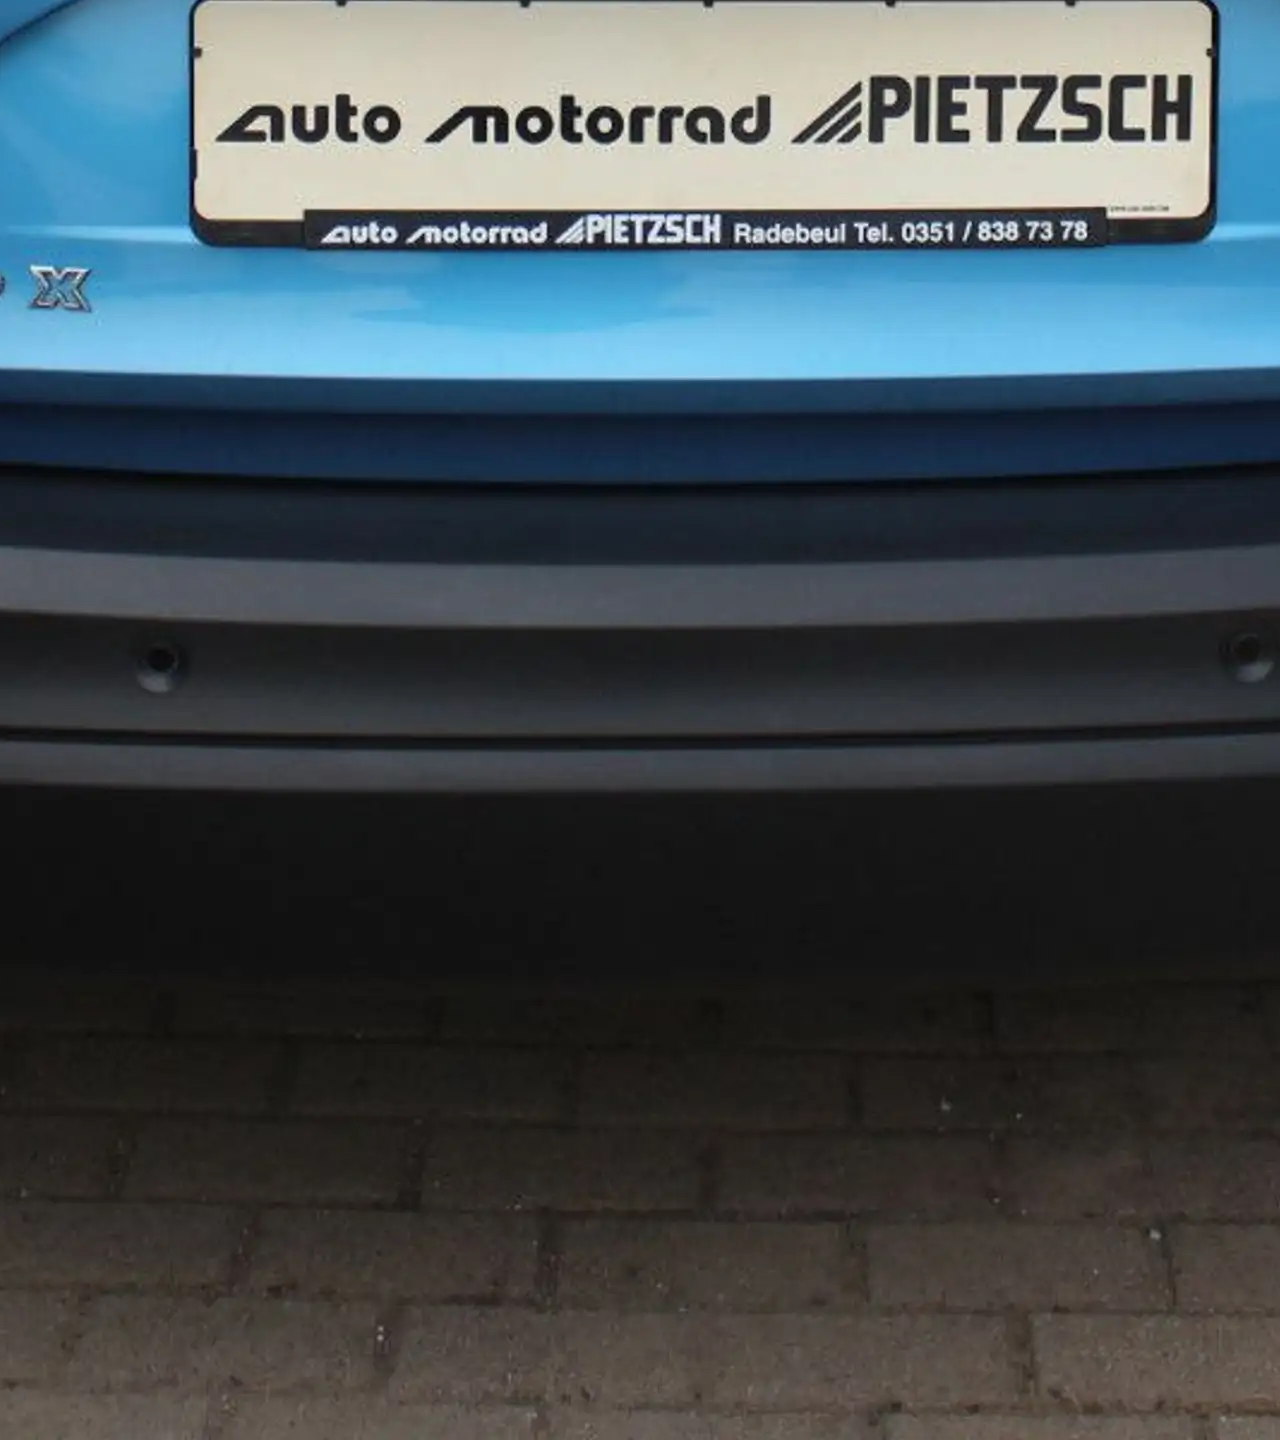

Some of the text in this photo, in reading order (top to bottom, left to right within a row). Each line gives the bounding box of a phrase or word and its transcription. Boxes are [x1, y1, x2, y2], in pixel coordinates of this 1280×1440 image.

[424, 94, 771, 145] motorrad
[869, 74, 1193, 143] PIETZSCH
[406, 221, 547, 245] motorrad
[586, 214, 721, 244] PIETZSCH
[734, 222, 846, 245] Radebeul
[854, 222, 894, 243] Tel.
[901, 221, 955, 243] 0351
[962, 221, 971, 242] /
[978, 220, 1020, 242] 838
[1026, 220, 1054, 242] 73
[1061, 220, 1088, 242] 78
[29, 264, 92, 312] X
